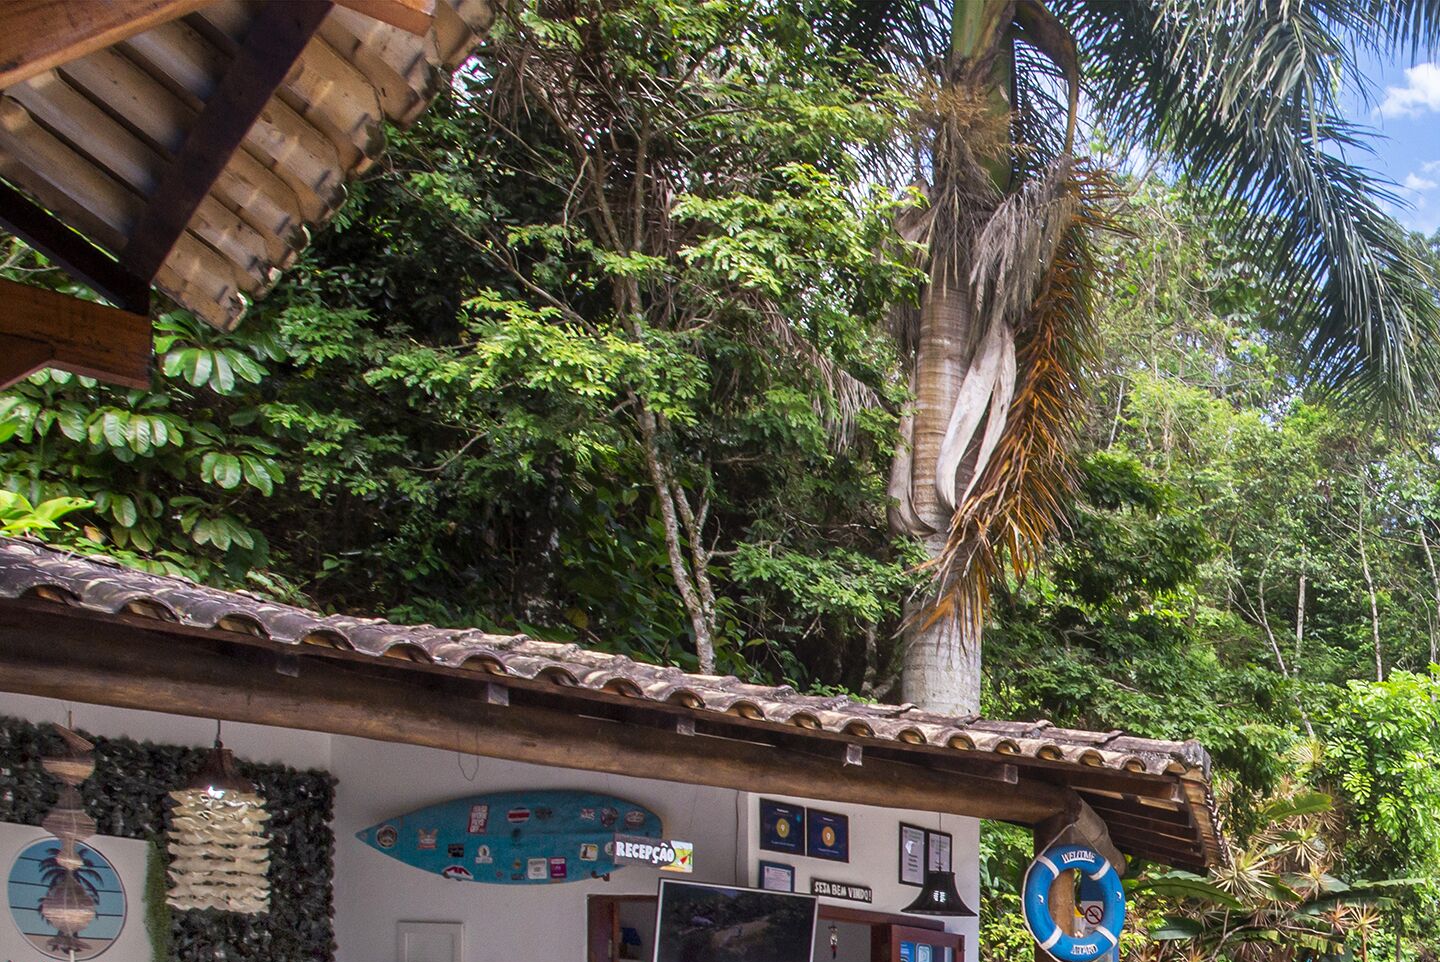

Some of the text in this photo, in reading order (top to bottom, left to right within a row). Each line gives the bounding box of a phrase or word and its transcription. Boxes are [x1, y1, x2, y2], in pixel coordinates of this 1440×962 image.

[1061, 850, 1096, 864] WELCOME
[814, 882, 831, 895] SEJA
[831, 885, 847, 897] BEM
